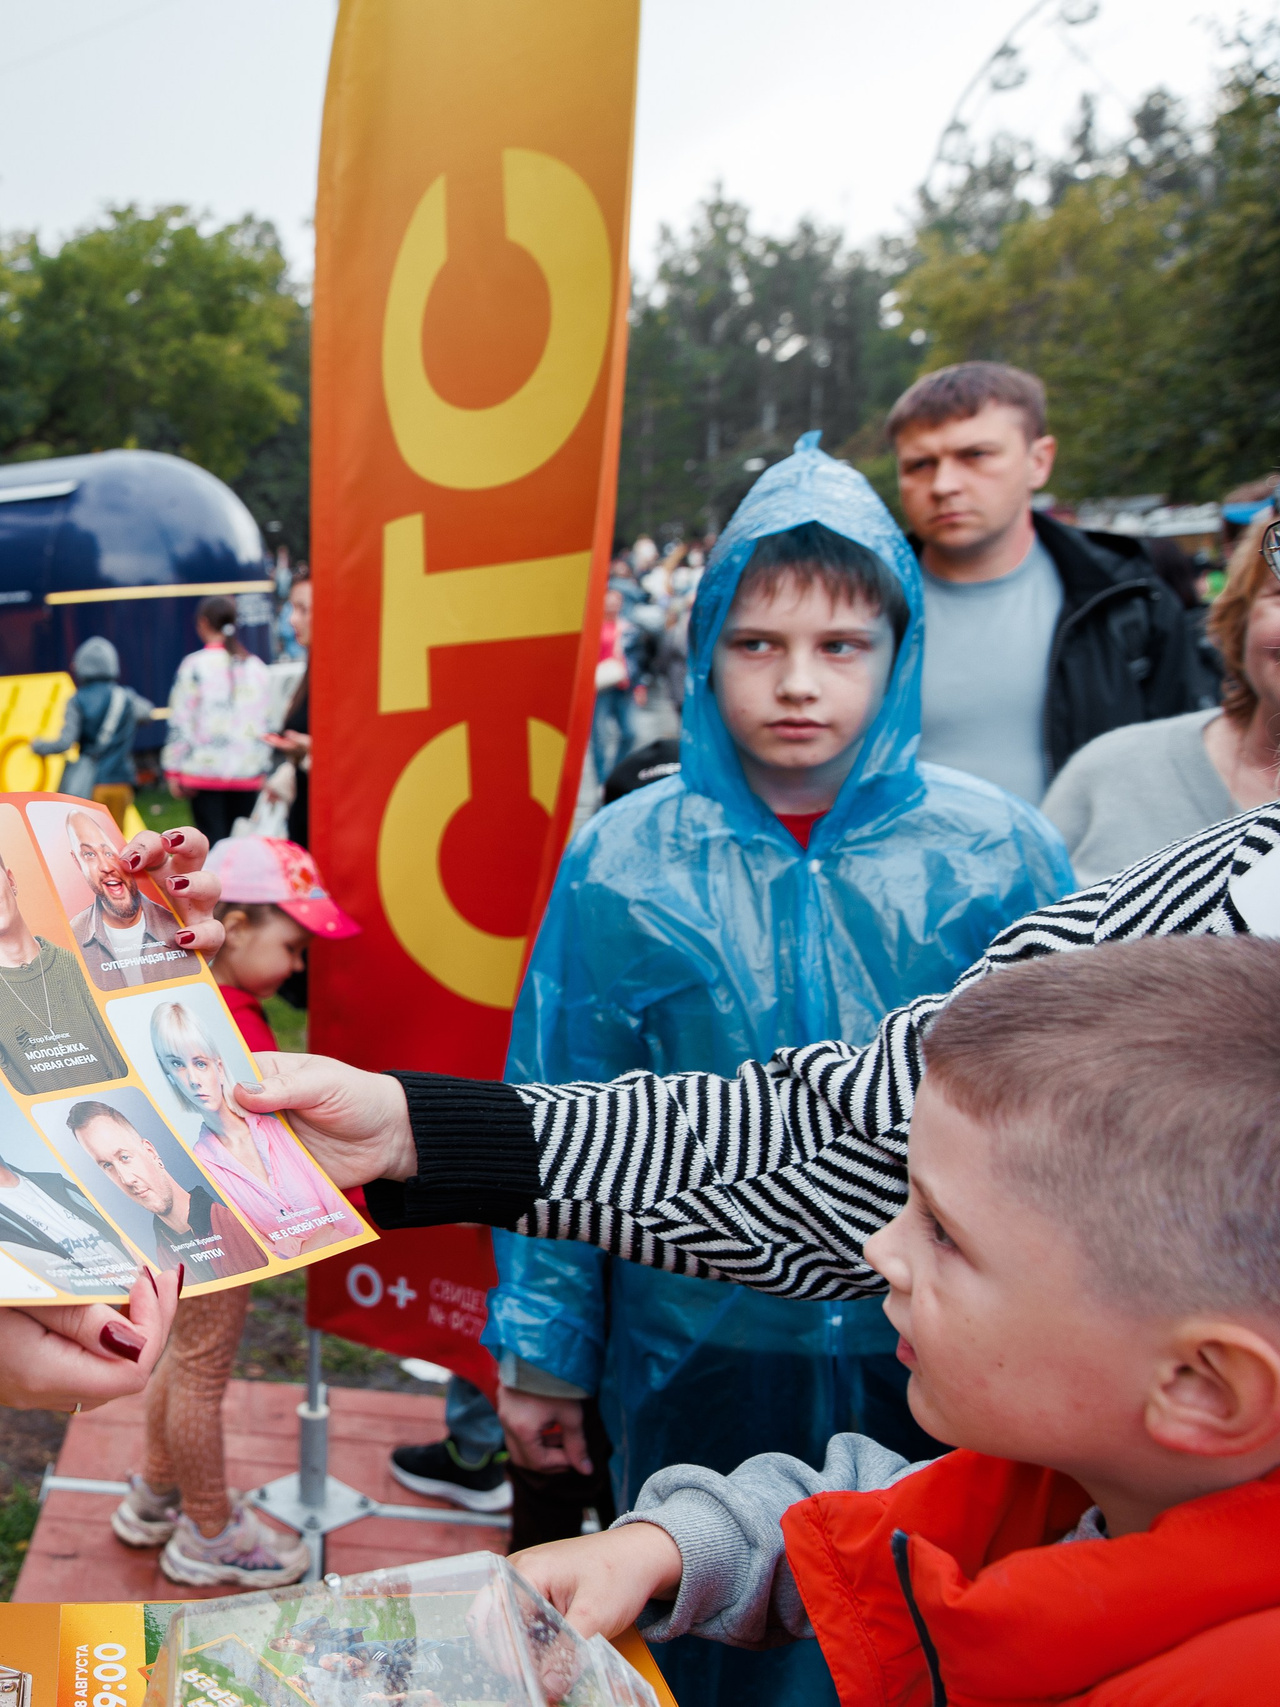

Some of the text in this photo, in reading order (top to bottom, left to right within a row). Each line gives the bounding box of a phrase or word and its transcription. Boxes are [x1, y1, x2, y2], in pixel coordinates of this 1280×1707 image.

[378, 147, 613, 1010] СТС
[166, 950, 188, 962] ДЕТИ
[30, 1054, 98, 1073] НОВАЯ СМЕНА
[268, 1210, 346, 1242] НЕ В СВОЕЙ ТАРЕЛКЕ
[190, 1247, 225, 1263] ПРЯТКИ
[346, 1263, 418, 1309] 0+
[74, 1643, 89, 1698] АВГУСТА
